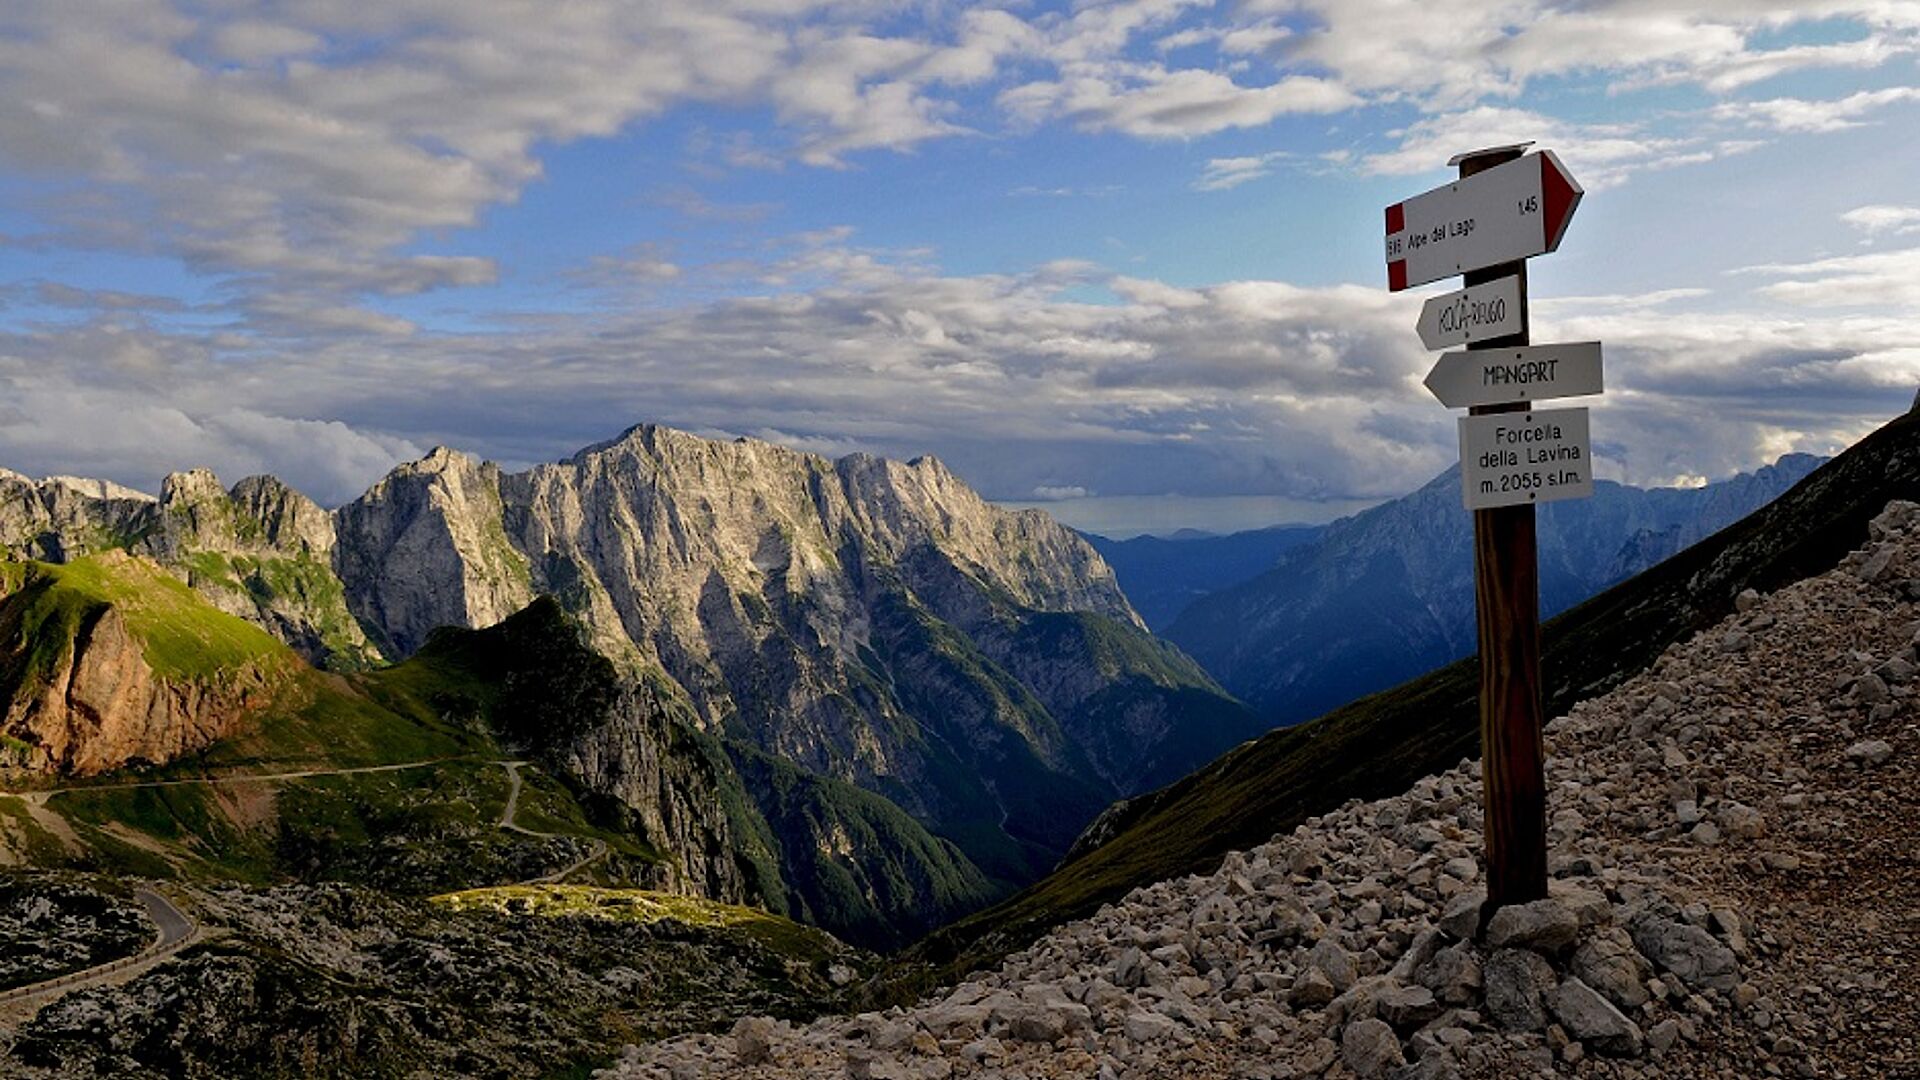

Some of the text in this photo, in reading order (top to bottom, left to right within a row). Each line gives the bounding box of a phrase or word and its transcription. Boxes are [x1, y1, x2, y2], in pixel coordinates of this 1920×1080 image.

[1408, 234, 1428, 250] Alpe
[1431, 224, 1446, 242] del
[1449, 218, 1475, 238] Lago
[1483, 360, 1559, 386] MANGART
[1496, 424, 1562, 444] Forcella
[1479, 444, 1580, 468] della Lavina
